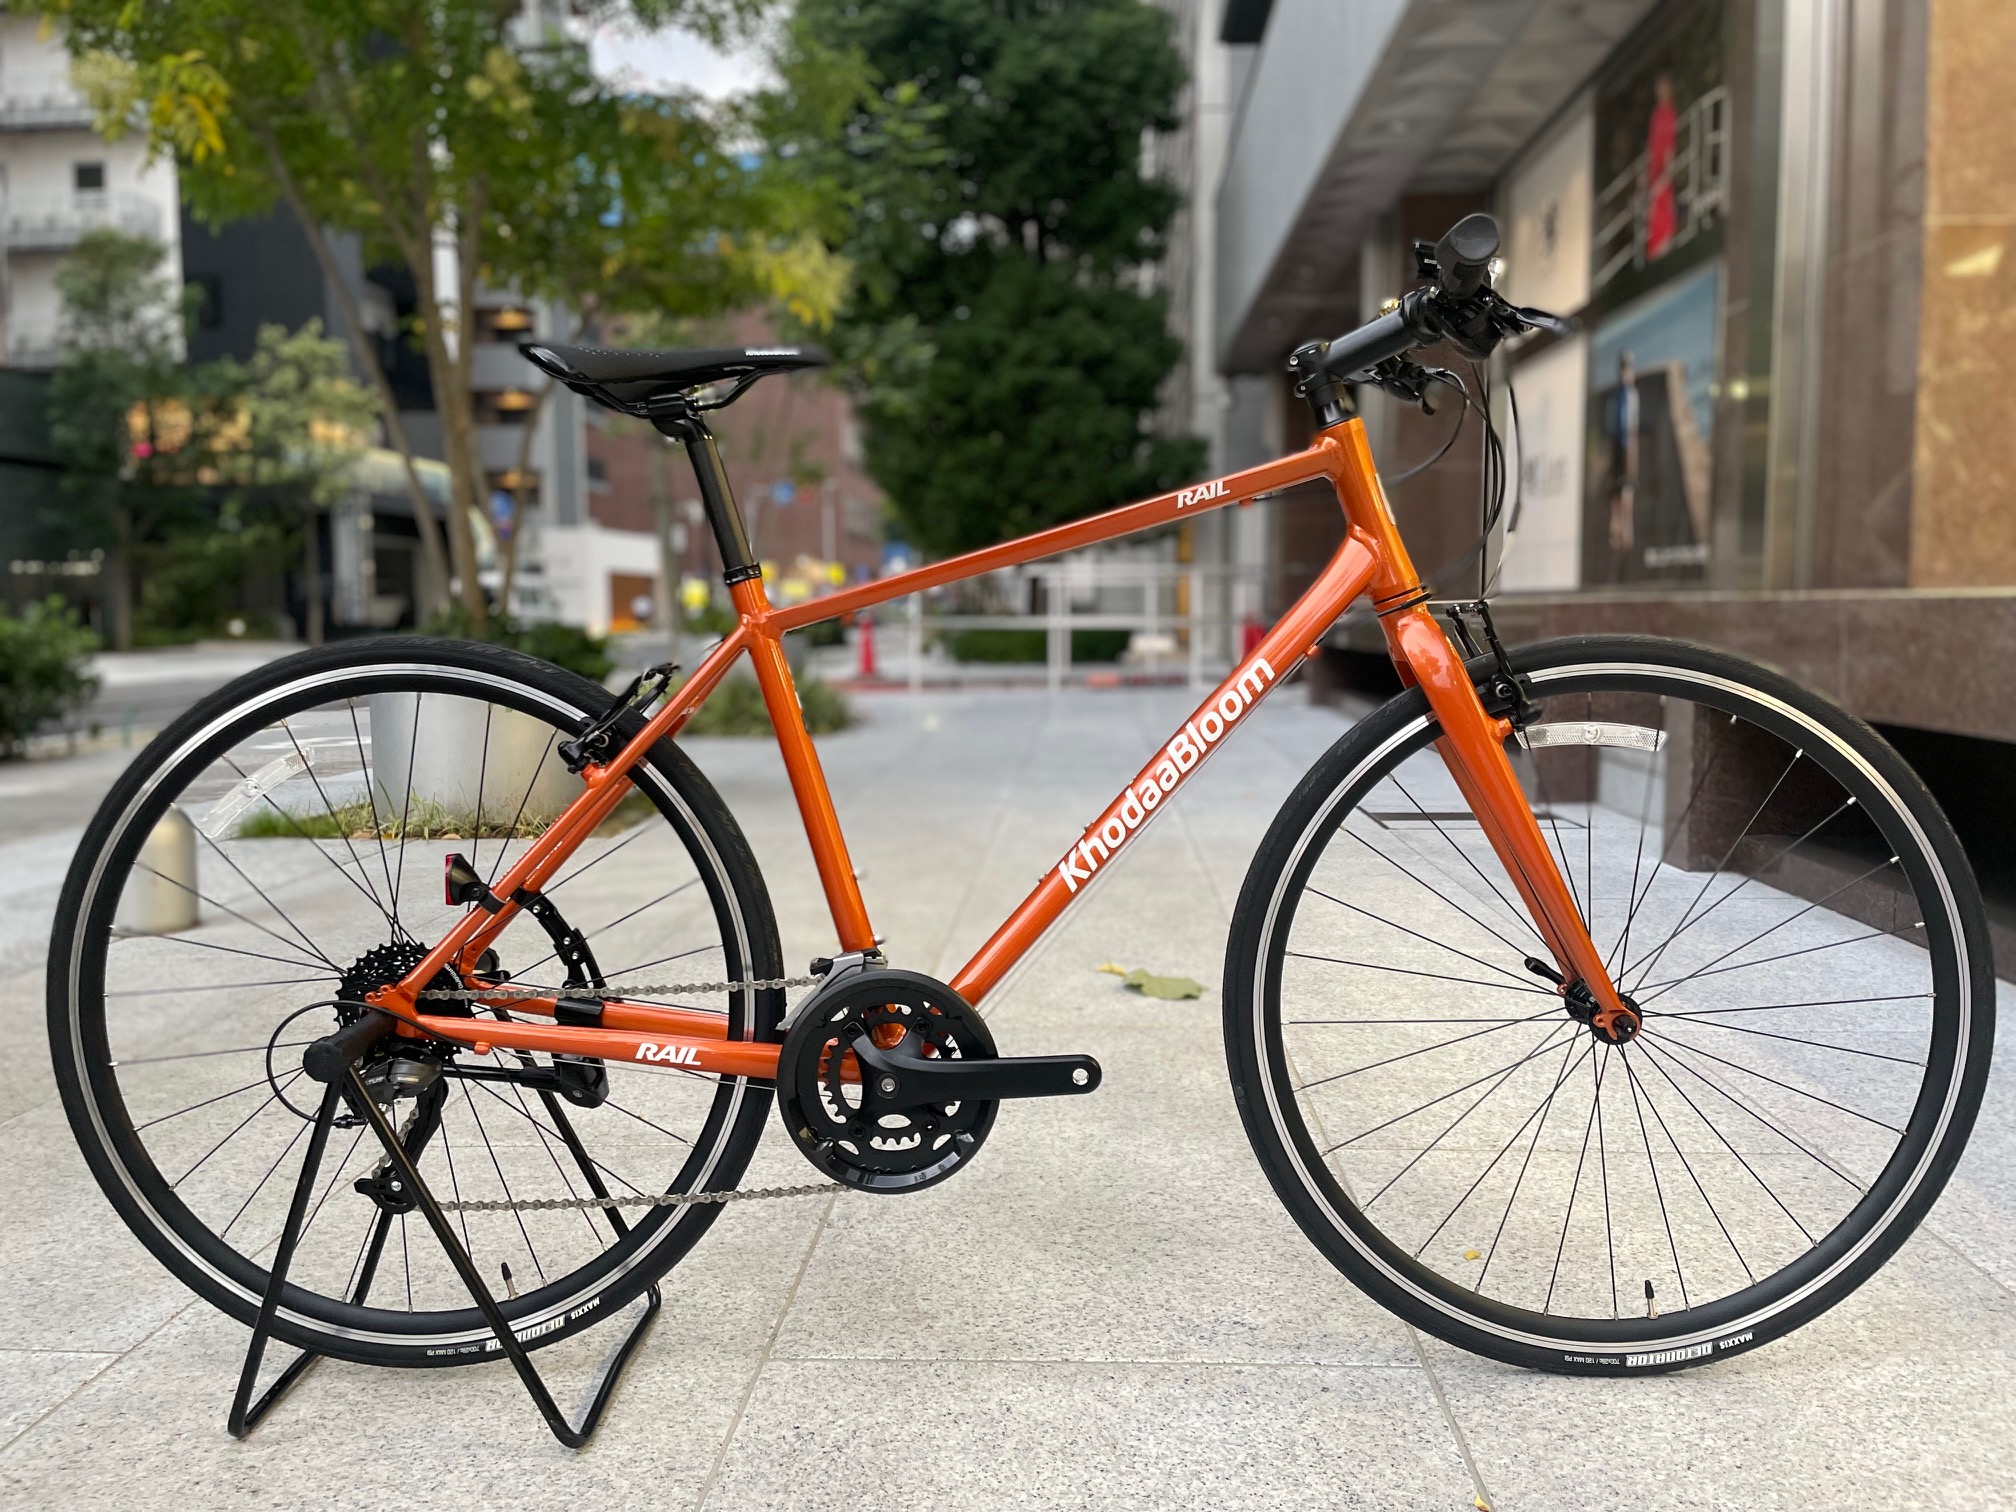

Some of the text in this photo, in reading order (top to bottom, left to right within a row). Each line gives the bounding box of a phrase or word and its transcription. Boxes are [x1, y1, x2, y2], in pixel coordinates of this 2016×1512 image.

[1177, 481, 1231, 509] RAIL
[1058, 657, 1276, 893] KhodaaBloom
[635, 1042, 702, 1066] RAIL
[570, 1297, 600, 1320] MAXXIS
[1626, 1332, 1753, 1367] MAXXIS DETONATOR
